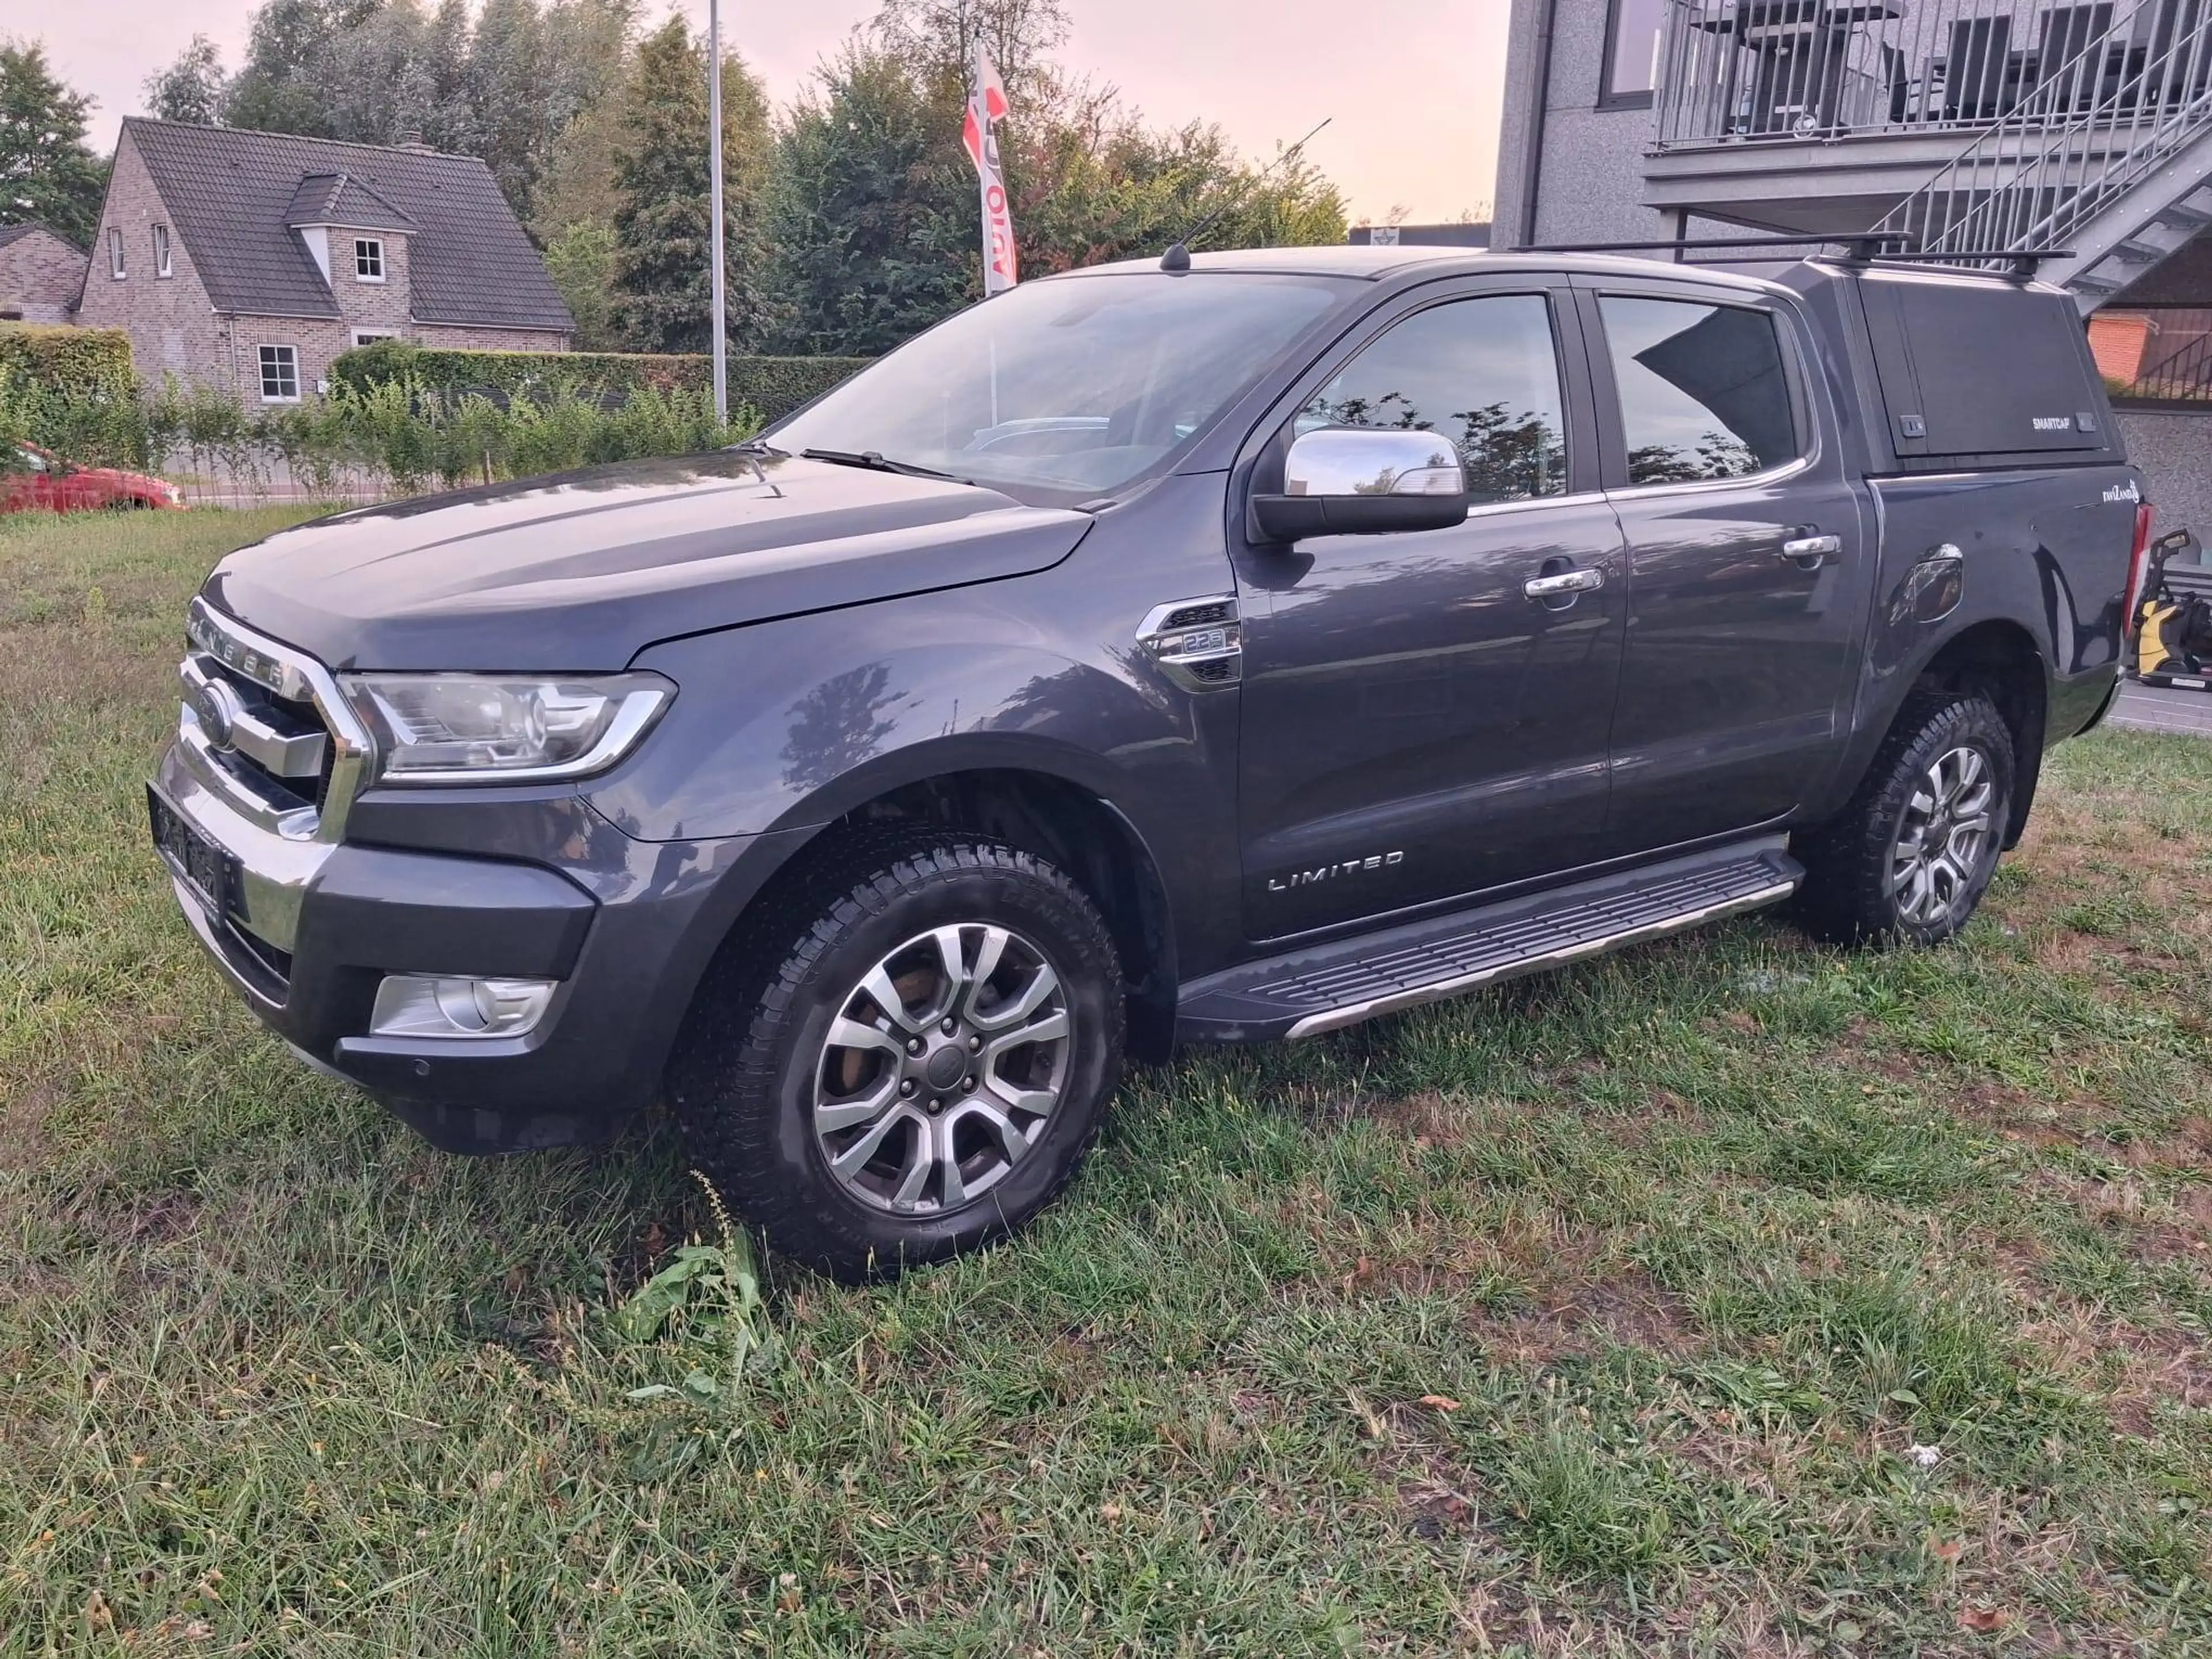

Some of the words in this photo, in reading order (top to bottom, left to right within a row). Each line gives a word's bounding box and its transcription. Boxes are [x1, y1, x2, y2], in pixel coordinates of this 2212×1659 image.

[986, 185, 1007, 279] AUTO
[2032, 417, 2070, 430] SMARTCAP
[1268, 851, 1404, 891] LIMITED
